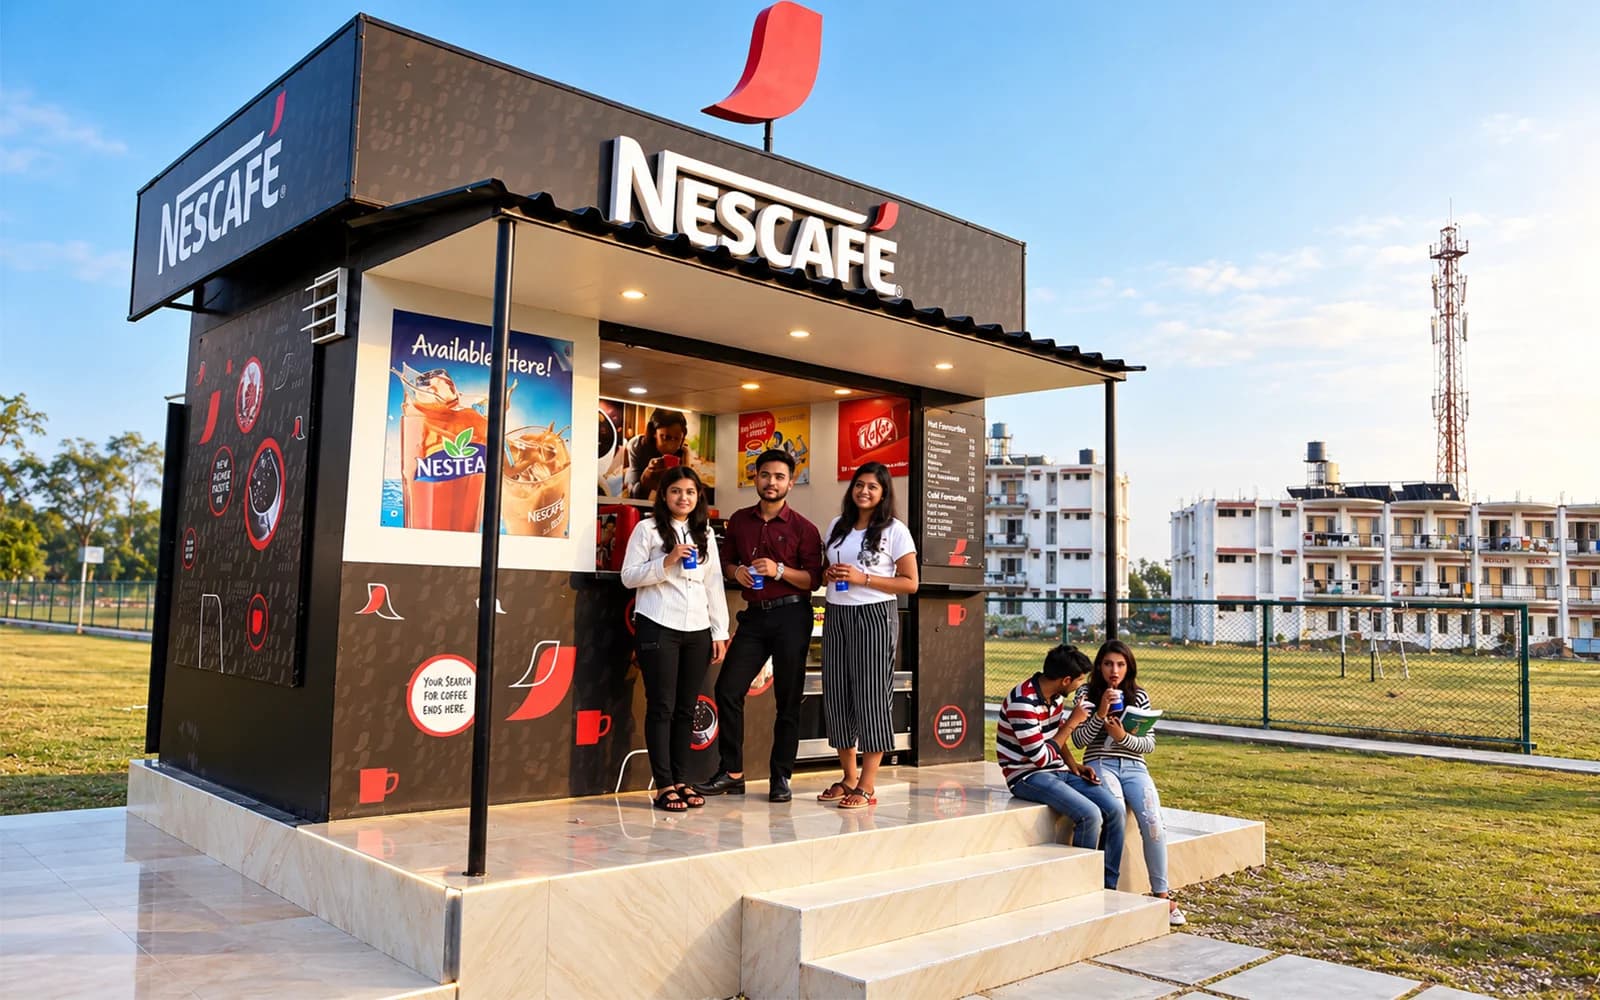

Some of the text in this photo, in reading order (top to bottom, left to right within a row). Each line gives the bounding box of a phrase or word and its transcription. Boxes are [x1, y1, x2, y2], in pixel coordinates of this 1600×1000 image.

[158, 91, 287, 276] NESCAFÉ
[608, 135, 898, 296] NESCAFÉ
[411, 333, 553, 377] Available Here!
[416, 456, 486, 477] NESTEA
[423, 675, 472, 688] YOUR SEARCH
[424, 690, 468, 701] FOR COFFEE
[423, 703, 466, 715] ENDS HERE.
